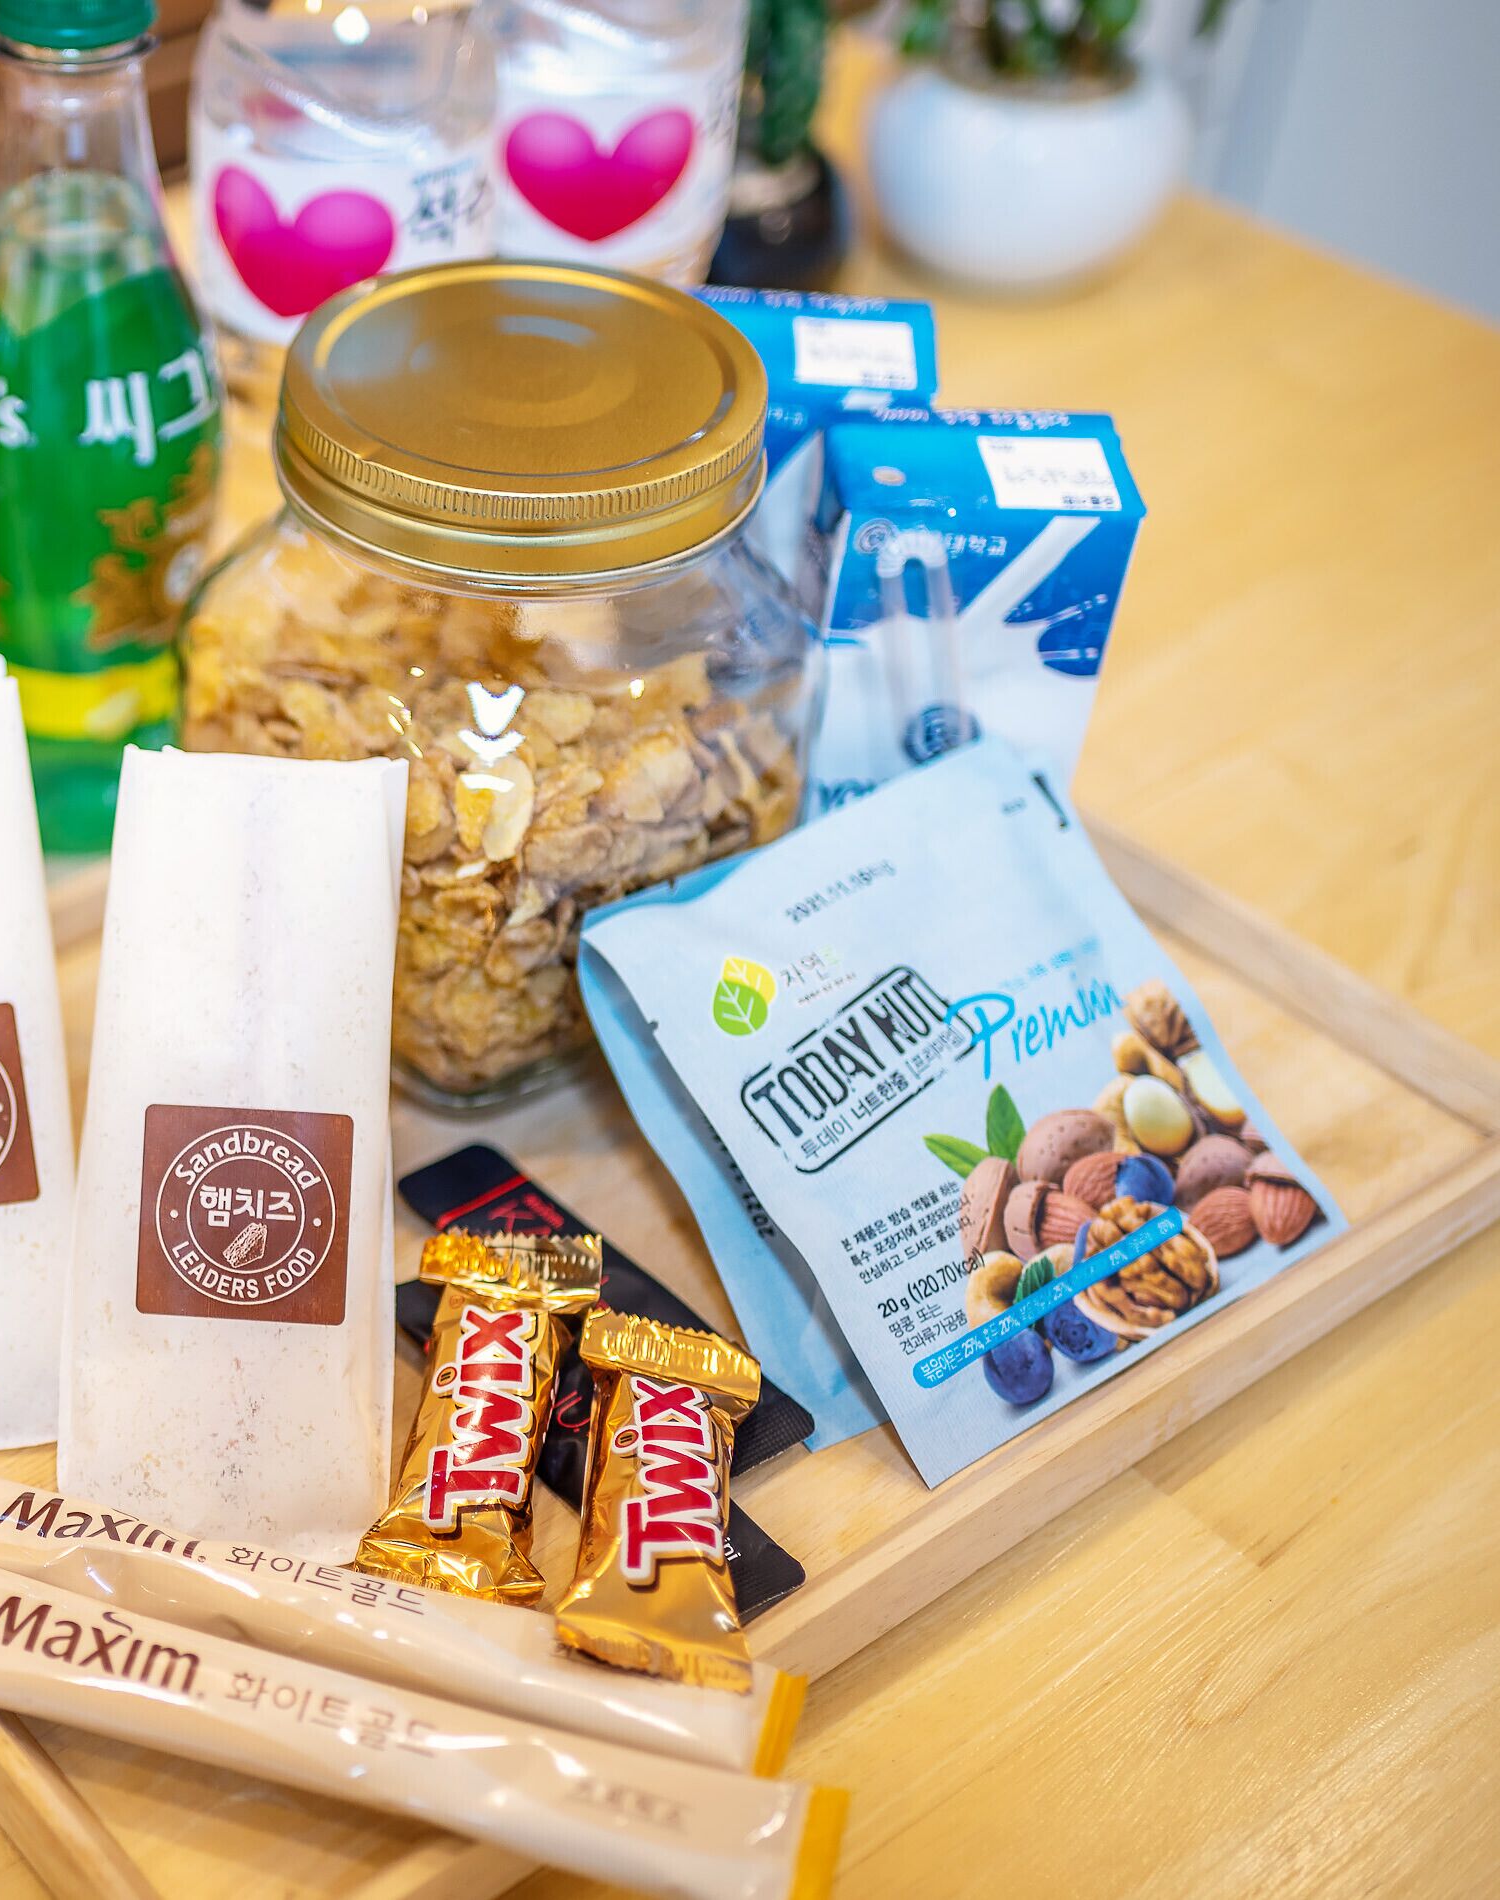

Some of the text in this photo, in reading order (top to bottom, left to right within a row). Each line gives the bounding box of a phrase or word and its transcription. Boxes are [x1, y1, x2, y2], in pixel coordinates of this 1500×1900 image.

[750, 974, 944, 1137] TODAY NUT
[175, 1131, 321, 1191] Sandbread
[800, 1114, 854, 1160] 투데이
[199, 1184, 296, 1228] 햄치즈
[850, 1250, 872, 1268] 특수
[874, 1222, 918, 1256] 포장지에
[853, 1219, 888, 1246] 제품은
[171, 1240, 316, 1299] LEADERS FOOD
[859, 1255, 905, 1285] 안심하고
[903, 1235, 938, 1261] 드셔도
[888, 1302, 944, 1339] 땅콩 또는
[899, 1308, 969, 1357] 견과류가공품
[224, 1545, 426, 1616] 화이트골드
[224, 1670, 440, 1760] 화이트골드
